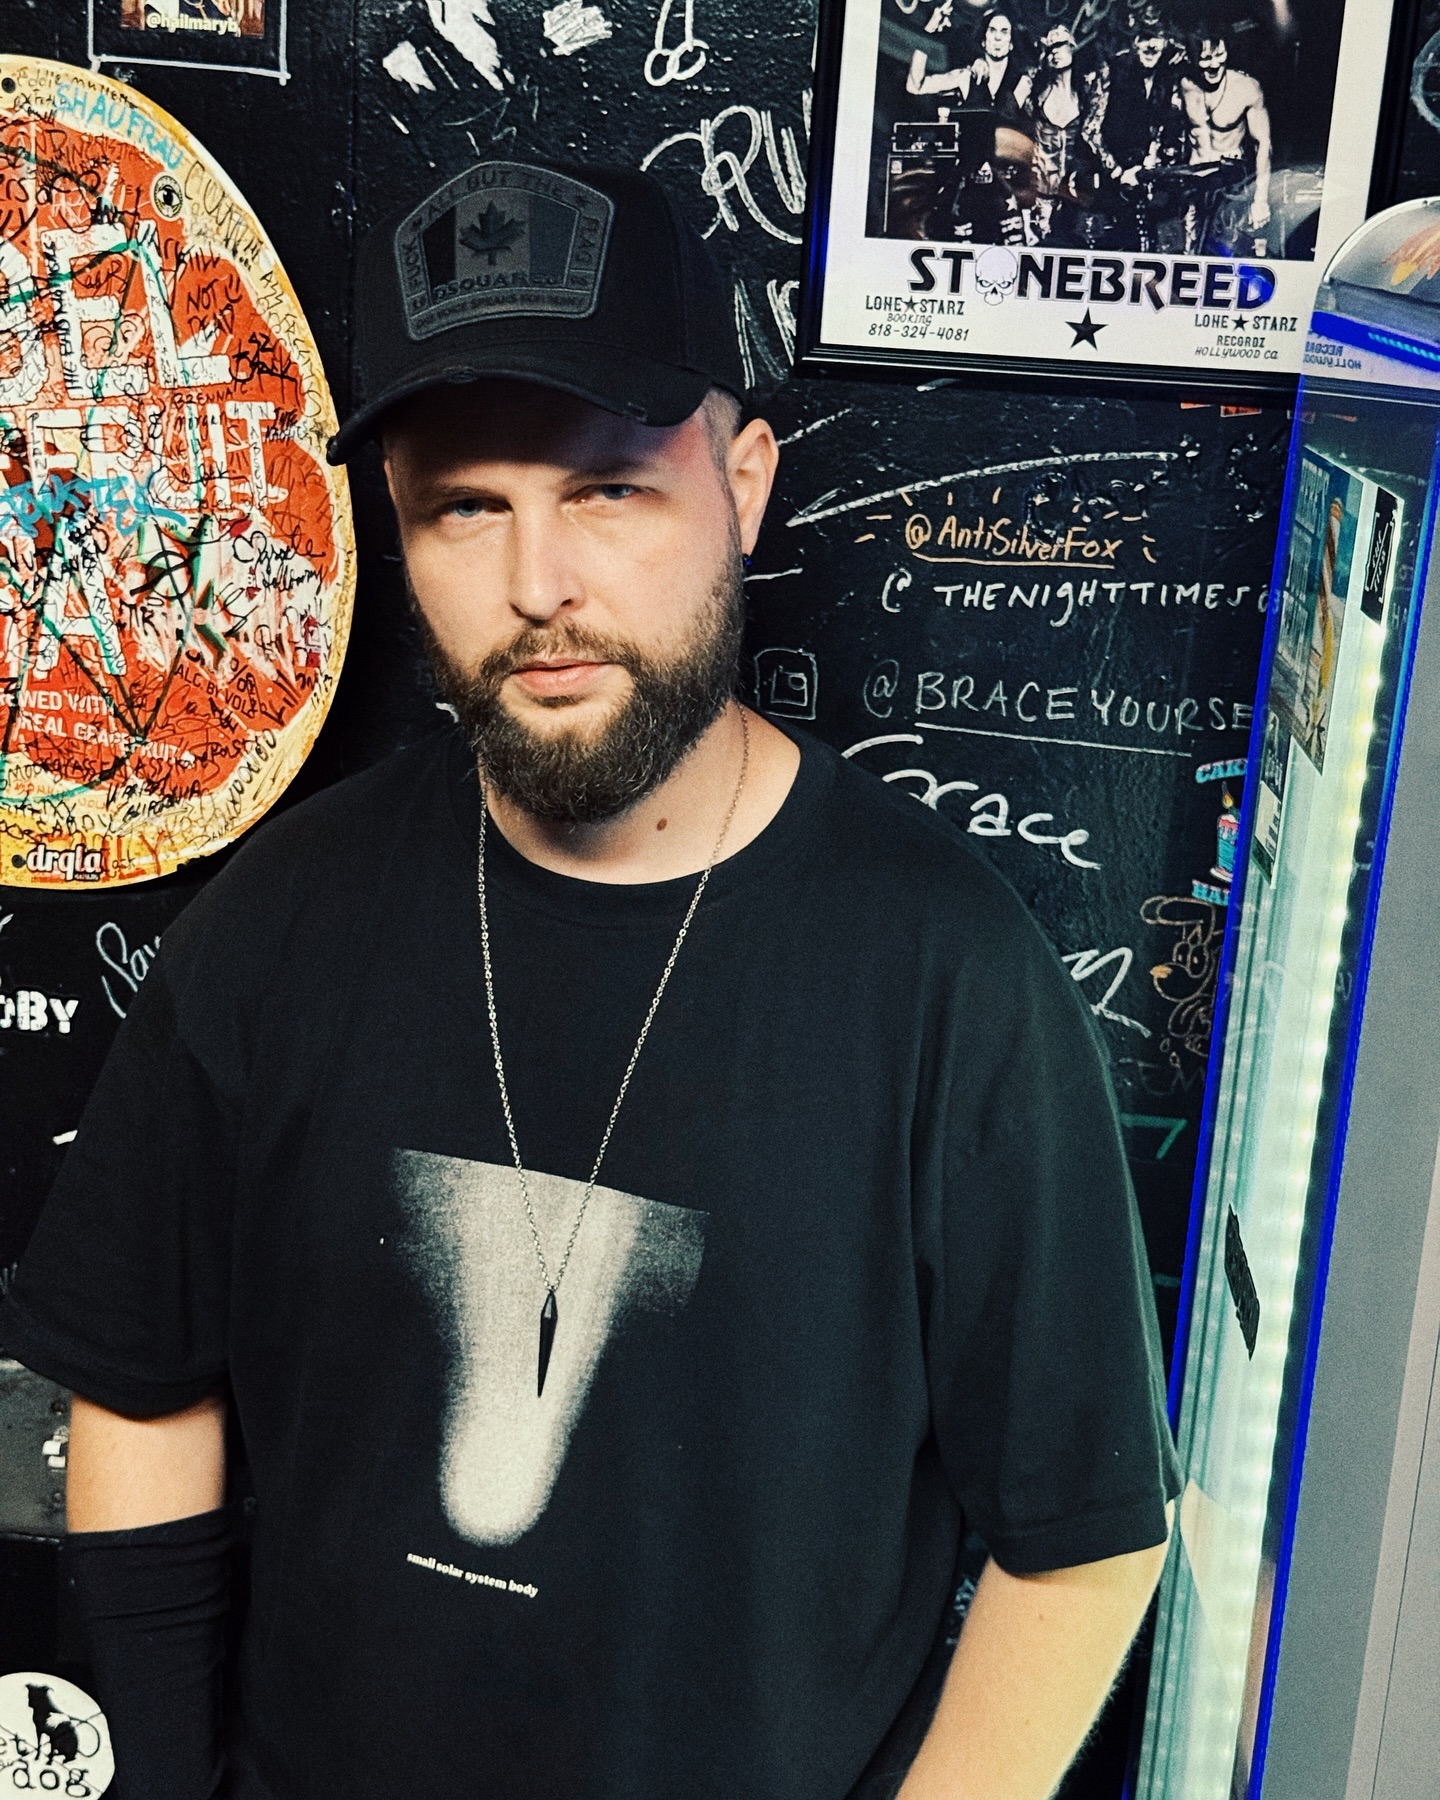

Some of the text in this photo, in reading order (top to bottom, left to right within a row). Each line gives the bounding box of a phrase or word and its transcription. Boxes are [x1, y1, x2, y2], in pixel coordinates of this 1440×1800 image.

[919, 299, 965, 316] STARZ
[868, 323, 970, 342] 818-324-4081
[1252, 315, 1299, 332] STARZ
[407, 1553, 539, 1598] small solar system body
[13, 1758, 91, 1798] dog
